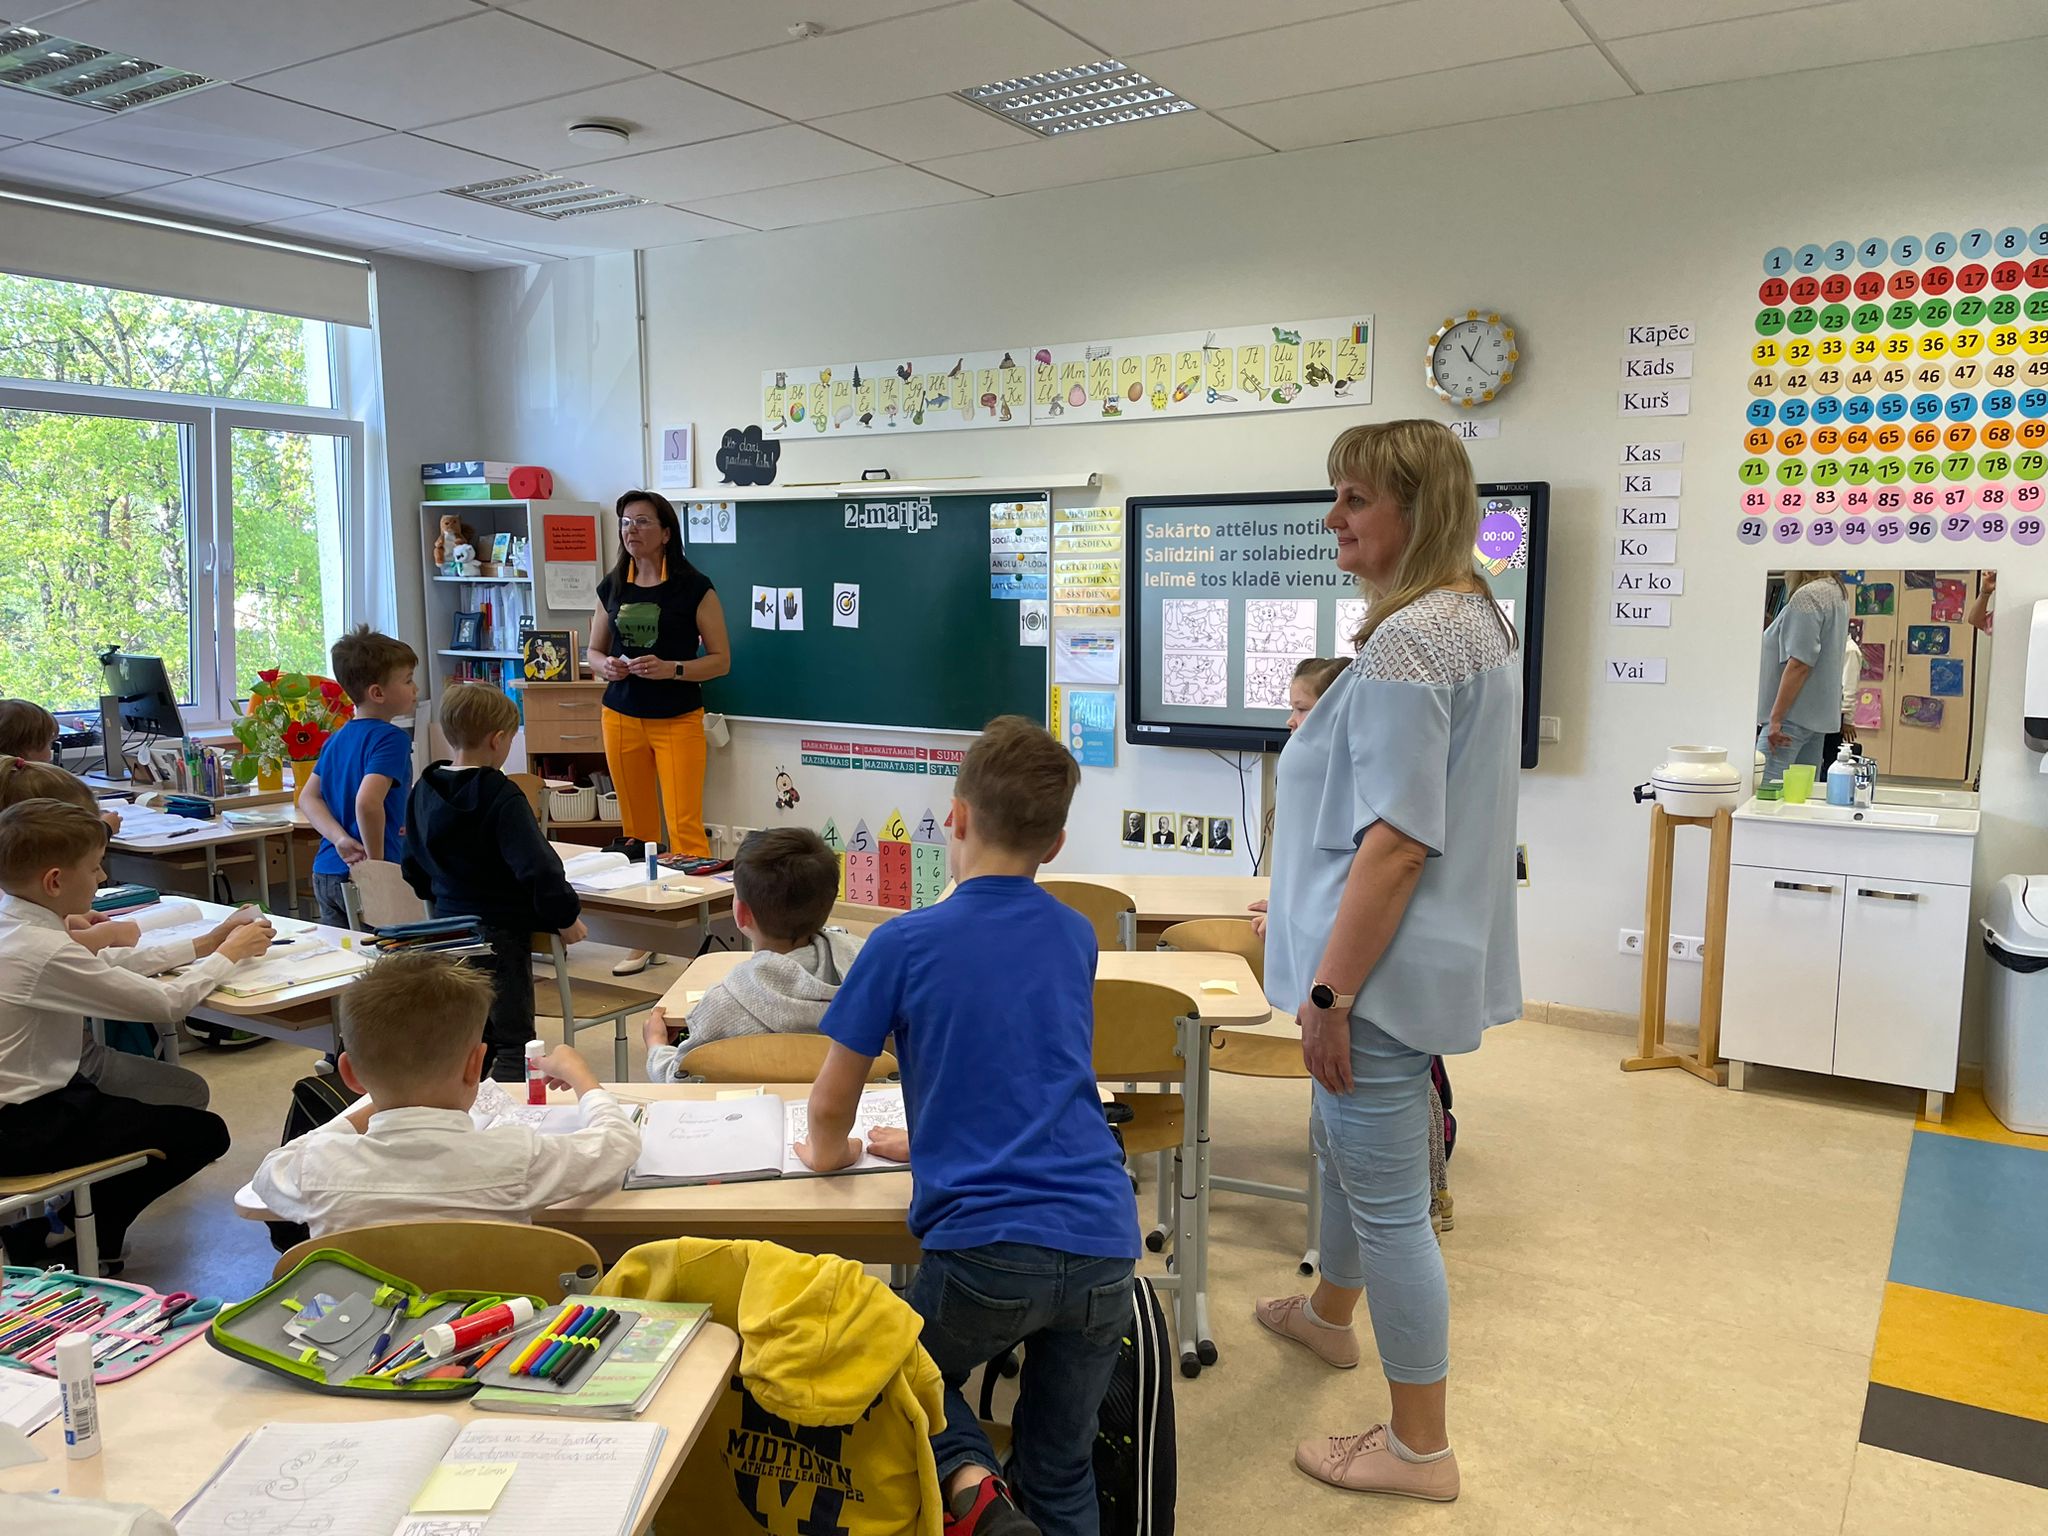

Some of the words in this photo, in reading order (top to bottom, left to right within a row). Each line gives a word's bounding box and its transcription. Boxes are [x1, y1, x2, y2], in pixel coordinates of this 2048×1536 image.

[1773, 256, 1781, 269] 1
[1804, 253, 1813, 266] 2
[1835, 248, 1844, 261] 3
[1866, 244, 1876, 256] 4
[1902, 245, 1912, 258] 5
[1935, 242, 1946, 255] 6
[1971, 234, 1981, 247] 7
[2004, 235, 2014, 248] 8
[1766, 284, 1784, 297] 11
[1797, 283, 1815, 296] 12
[1825, 281, 1844, 294] 13
[1860, 282, 1879, 295] 14
[1895, 276, 1914, 290] 15
[1927, 272, 1947, 285] 16
[1965, 273, 1985, 286] 17
[1996, 269, 2016, 283] 18
[1762, 312, 1780, 326] 21
[1794, 309, 1812, 323] 22
[1824, 315, 1843, 328] 23
[1859, 310, 1879, 325] 24
[1892, 306, 1912, 319] 25
[1927, 306, 1947, 319] 26
[1961, 301, 1982, 315] 27
[1994, 301, 2015, 314] 28
[2030, 300, 2048, 314] 29
[1629, 325, 1690, 346] Kāpēc
[1757, 344, 1775, 358] 31
[1791, 345, 1810, 359] 32
[1823, 340, 1842, 354] 33
[1856, 341, 1875, 354] 34
[1888, 340, 1908, 353] 35
[1923, 338, 1944, 351] 36
[1957, 335, 1978, 348] 37
[1996, 332, 2017, 346] 38
[2029, 330, 2048, 344] 39
[1626, 358, 1675, 377] Kāds
[1754, 374, 1772, 387] 41
[1788, 375, 1807, 388] 42
[1819, 371, 1839, 384] 43
[1852, 370, 1872, 384] 44
[1884, 369, 1904, 383] 45
[1919, 370, 1939, 383] 46
[1955, 365, 1976, 379] 47
[1993, 365, 2015, 378] 48
[2028, 362, 2048, 375] 49
[1623, 392, 1669, 410] Kurš
[1752, 404, 1769, 417] 51
[1787, 405, 1805, 419] 52
[1818, 400, 1837, 414] 53
[1849, 402, 1869, 415] 54
[1882, 400, 1902, 414] 55
[1917, 400, 1937, 415] 56
[1951, 397, 1970, 413] 57
[1991, 396, 2011, 410] 58
[2026, 393, 2047, 407] 59
[1750, 433, 1768, 446] 61
[1784, 433, 1804, 449] 62
[1818, 431, 1837, 444] 63
[1848, 431, 1867, 444] 64
[1879, 430, 1899, 444] 65
[1915, 430, 1935, 443] 66
[1950, 428, 1970, 442] 67
[1989, 427, 2010, 441] 68
[2024, 424, 2045, 438] 69
[1625, 445, 1661, 462] Kas
[1745, 463, 1763, 476] 71
[1783, 464, 1803, 479] 72
[1818, 463, 1838, 477] 73
[1849, 463, 1869, 476] 74
[1878, 461, 1899, 478] 75
[1914, 461, 1934, 475] 76
[1948, 458, 1968, 472] 77
[1986, 457, 2007, 472] 78
[2022, 456, 2042, 469] 79
[1625, 475, 1652, 492] Kā
[1747, 493, 1765, 506] 81
[1782, 494, 1801, 506] 82
[1816, 491, 1835, 504] 83
[1848, 492, 1868, 505] 84
[1878, 493, 1899, 507] 85
[1913, 492, 1933, 505] 86
[1945, 490, 1965, 505] 87
[1983, 490, 2004, 503] 88
[2018, 486, 2039, 501] 89
[1621, 508, 1667, 525] Kam
[1145, 523, 1211, 539] Sakārto
[1216, 521, 1278, 537] attēlus
[1483, 531, 1515, 541] 00:00
[1742, 522, 1760, 536] 91
[1780, 523, 1800, 537] 92
[1814, 522, 1833, 536] 93
[1846, 522, 1865, 535] 94
[1878, 522, 1898, 537] 95
[1909, 521, 1931, 535] 96
[1948, 518, 1970, 532] 97
[1983, 520, 2004, 533] 98
[2019, 521, 2040, 534] 99
[1145, 546, 1215, 563] Salīdzini
[1219, 550, 1237, 562] ar
[1620, 539, 1648, 556] Ko
[1145, 571, 1196, 587] Ielīmē
[1201, 573, 1227, 587] tos
[1232, 571, 1281, 587] kladē
[1286, 572, 1337, 587] vienu
[1617, 573, 1643, 589] Ar
[1648, 571, 1672, 589] ko
[1615, 602, 1652, 619] Kur
[1612, 661, 1644, 679] Vai
[823, 826, 838, 846] 4
[891, 819, 904, 840] 6
[922, 819, 935, 839] 7
[855, 831, 867, 851] 5
[727, 1428, 852, 1488] MIDTOWN
[741, 1461, 791, 1478] ATHLETIC
[795, 1468, 833, 1486] LEAGUE
